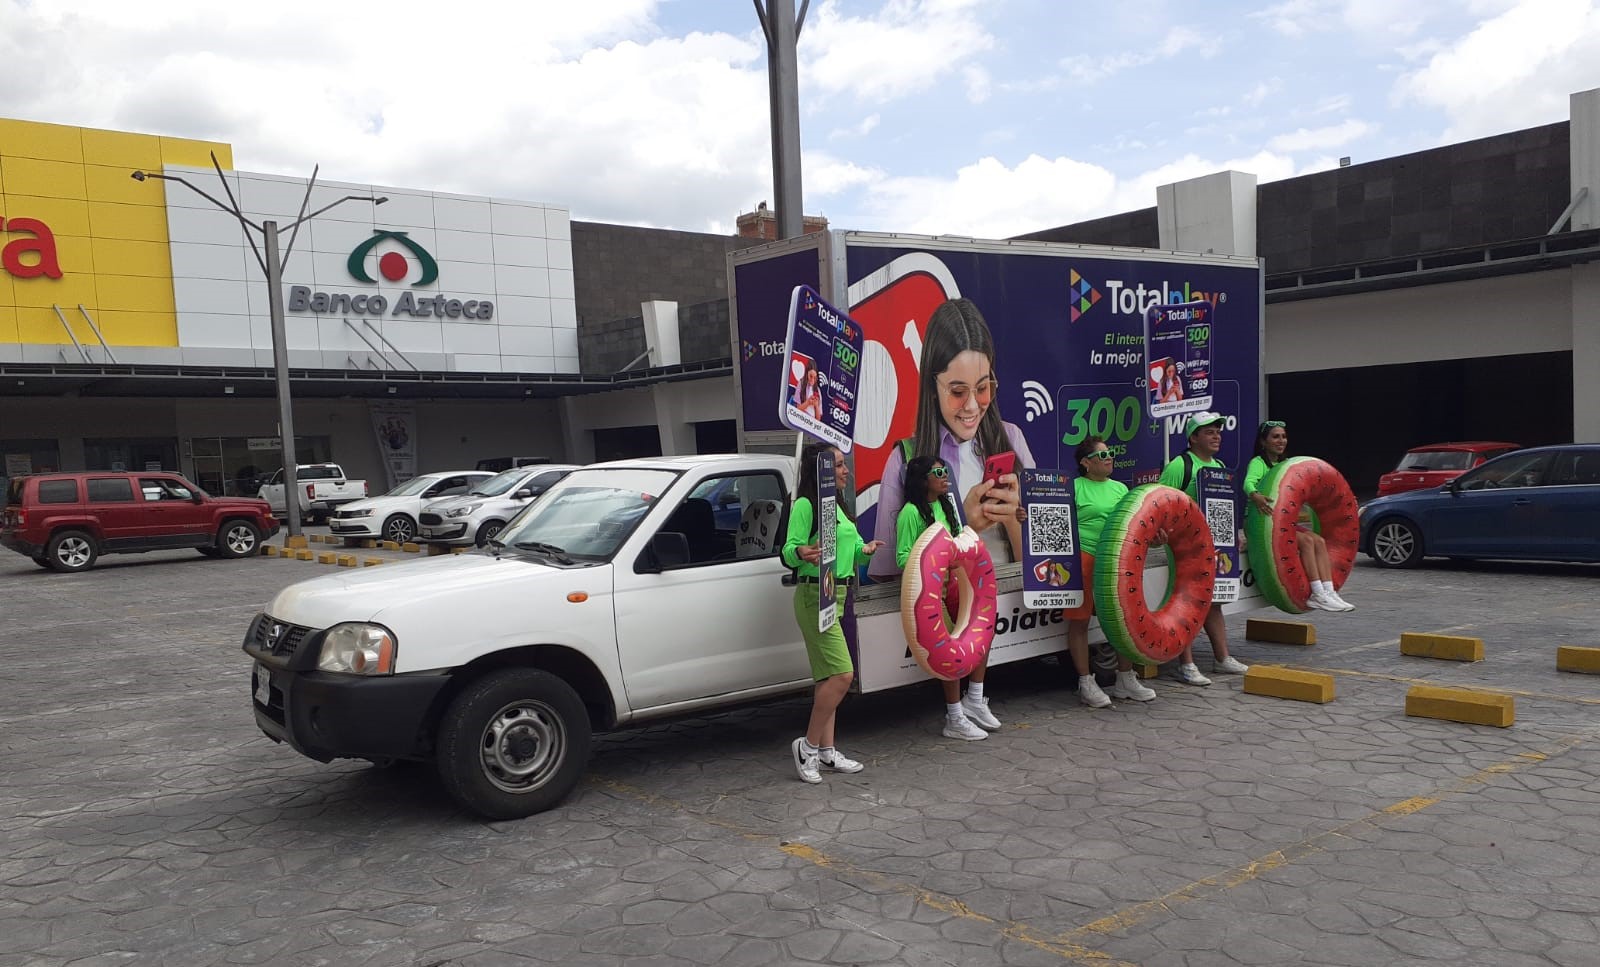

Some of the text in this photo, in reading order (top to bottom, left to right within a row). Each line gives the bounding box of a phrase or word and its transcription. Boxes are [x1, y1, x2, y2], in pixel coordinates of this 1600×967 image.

[0, 216, 63, 279] a
[289, 286, 494, 320] Banco Azteca
[817, 303, 855, 341] Totalplay
[1167, 308, 1205, 321] Totalplay
[1105, 333, 1114, 345] El
[1116, 333, 1145, 345] intern
[1187, 326, 1209, 342] 300
[759, 341, 785, 356] Tota
[834, 342, 858, 368] 300
[1090, 349, 1142, 368] la mejor
[1062, 396, 1141, 445] 300
[1035, 473, 1067, 485] Totalplay
[1149, 474, 1160, 482] ME
[1033, 599, 1048, 607] 800
[1049, 598, 1063, 606] 330
[994, 607, 1064, 635] biate
